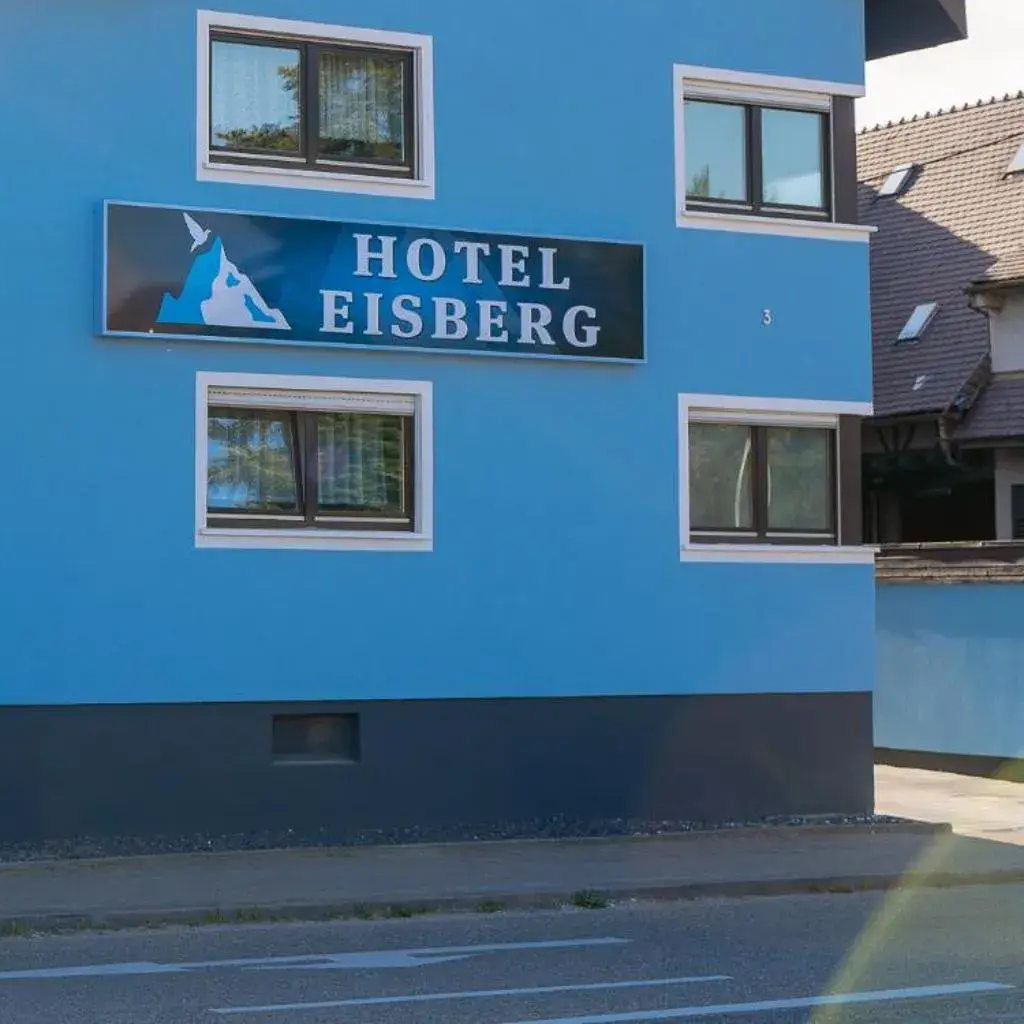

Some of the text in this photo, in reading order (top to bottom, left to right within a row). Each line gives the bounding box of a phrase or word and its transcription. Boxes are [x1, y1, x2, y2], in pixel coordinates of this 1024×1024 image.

[352, 233, 571, 290] HOTEL
[319, 289, 601, 348] EISBERG
[762, 309, 772, 325] 3
